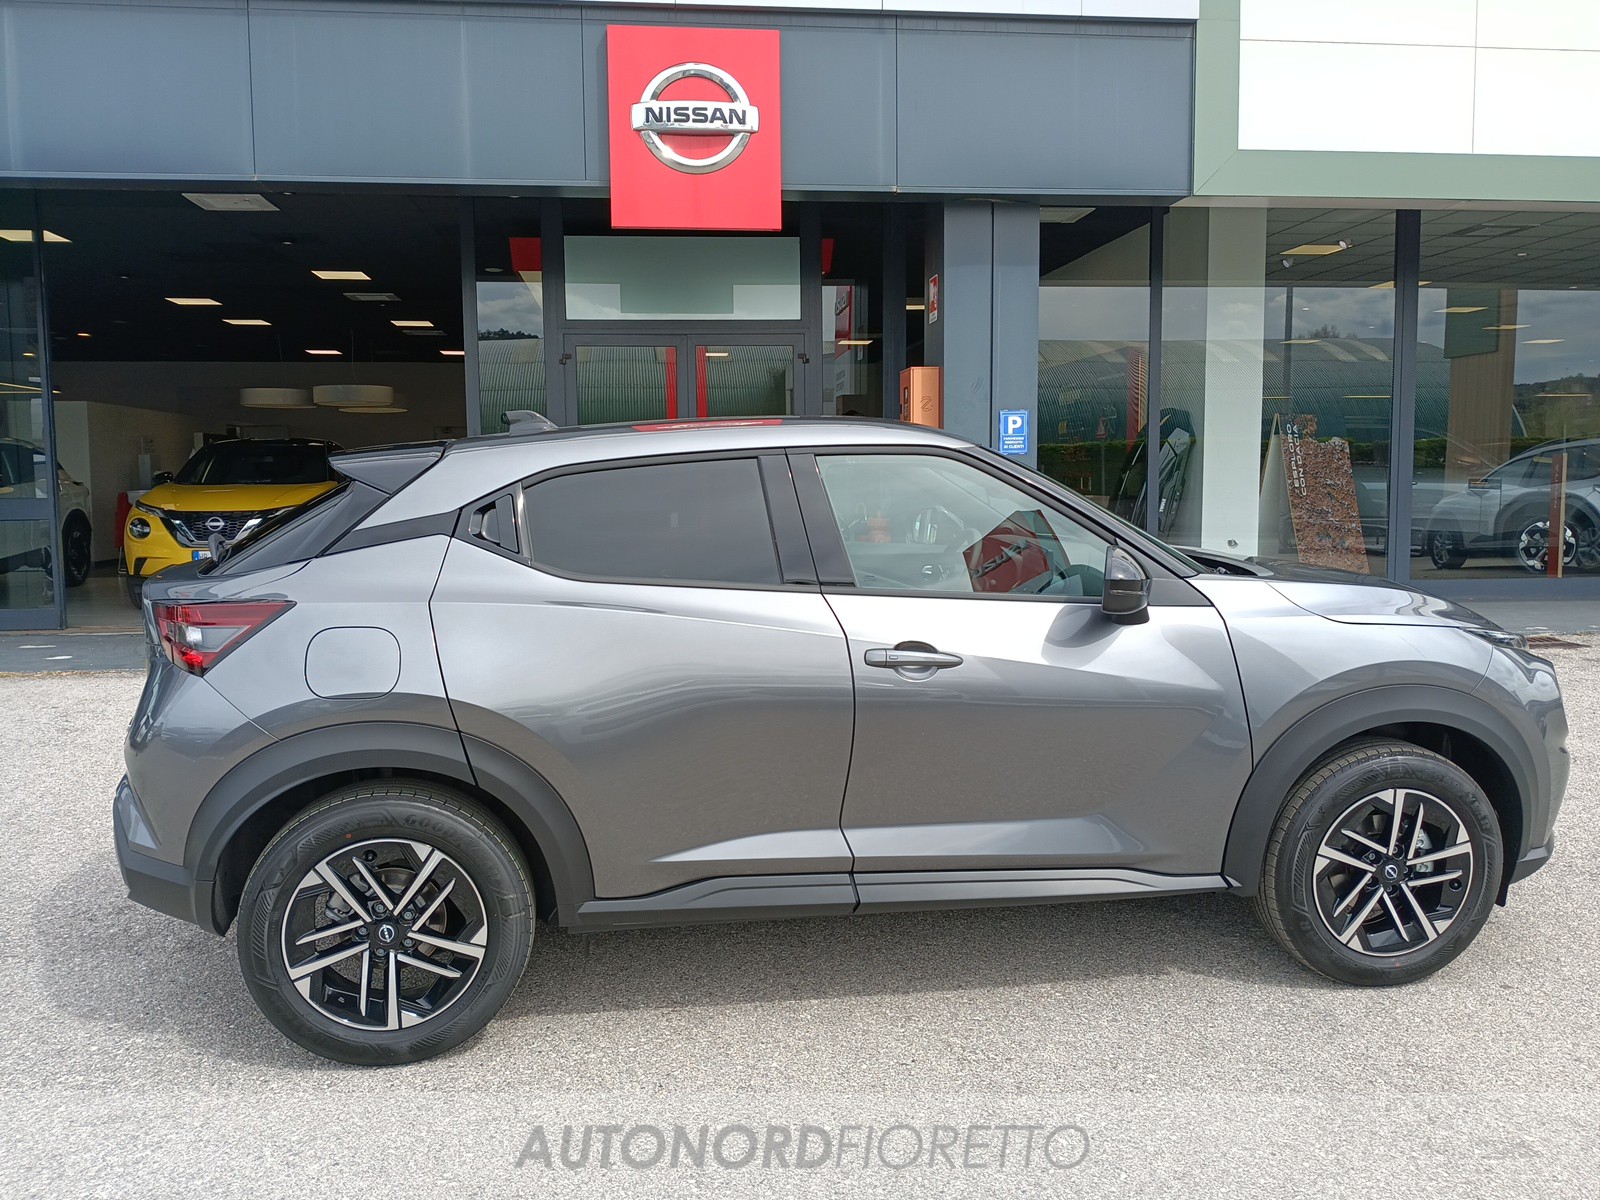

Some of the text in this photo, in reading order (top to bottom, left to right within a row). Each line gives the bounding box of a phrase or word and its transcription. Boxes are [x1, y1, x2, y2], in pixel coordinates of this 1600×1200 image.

[645, 106, 747, 126] NISSAN
[1007, 416, 1022, 435] P
[1286, 423, 1300, 488] ESPLORO
[1292, 424, 1307, 496] CON DACIA
